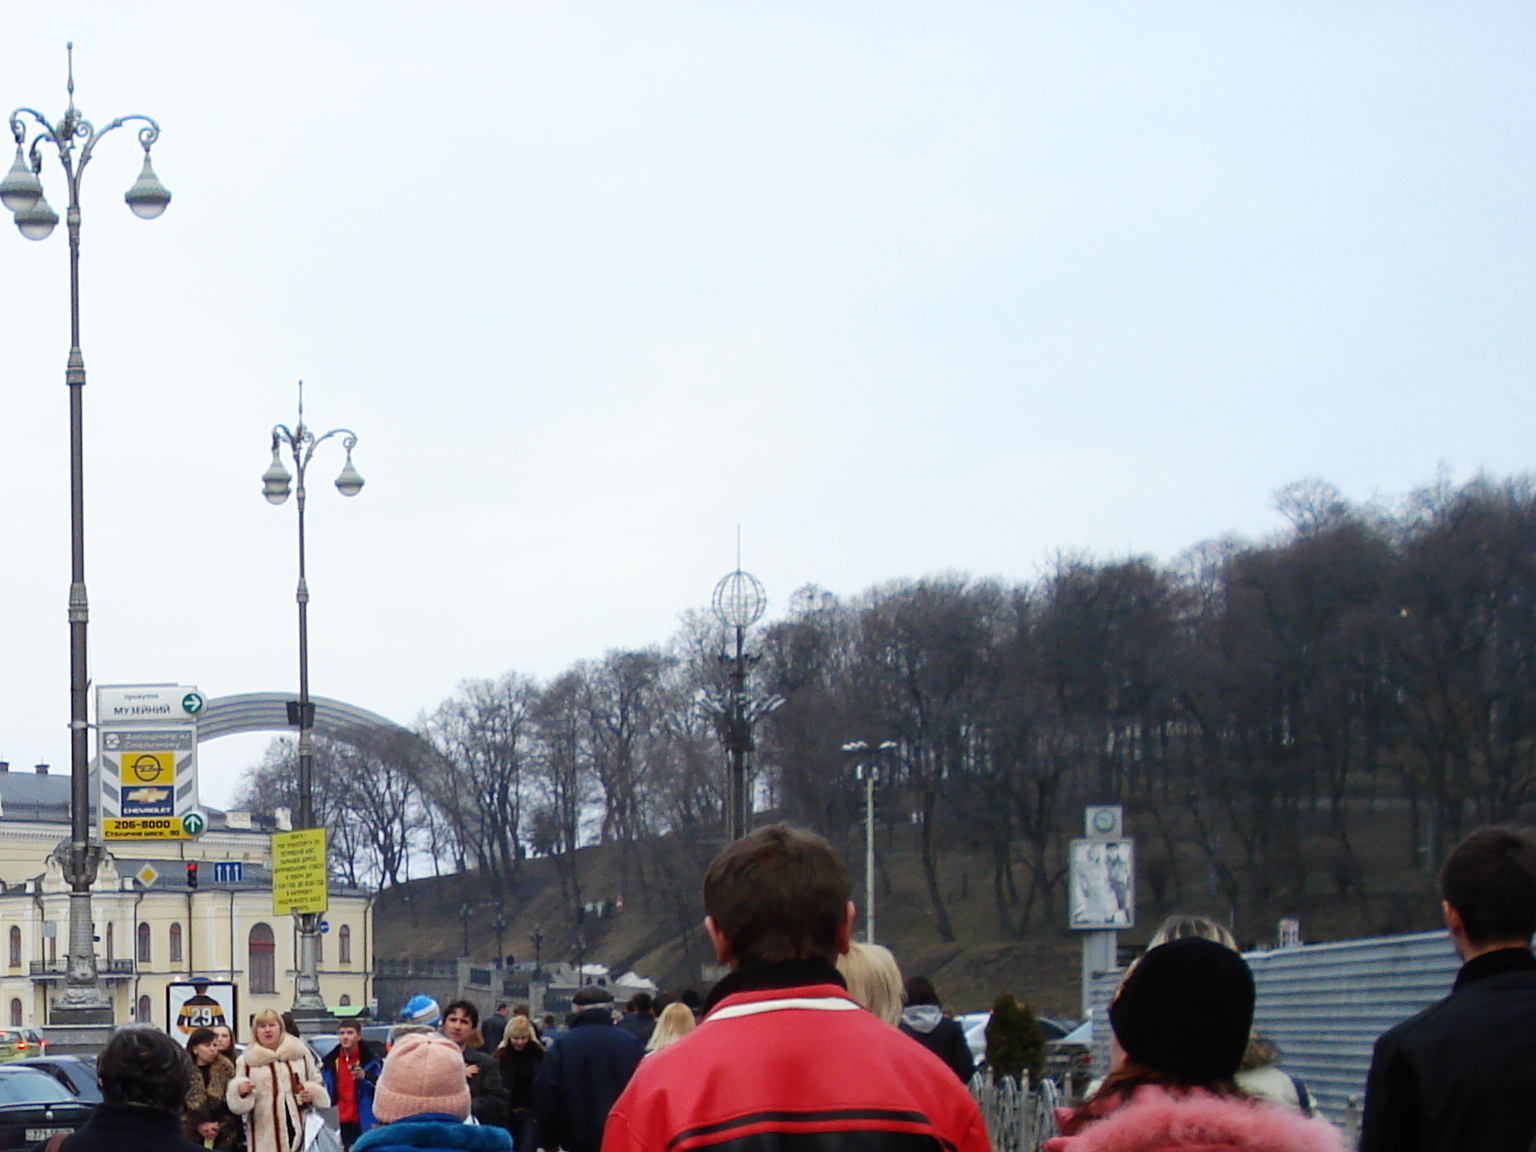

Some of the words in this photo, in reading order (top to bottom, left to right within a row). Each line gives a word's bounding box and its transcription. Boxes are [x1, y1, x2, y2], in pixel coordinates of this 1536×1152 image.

[114, 703, 171, 715] МУЗЕЙНИЙ
[123, 807, 172, 815] CHEVROLET
[114, 820, 170, 829] 206-8000
[190, 1007, 213, 1027] 29
